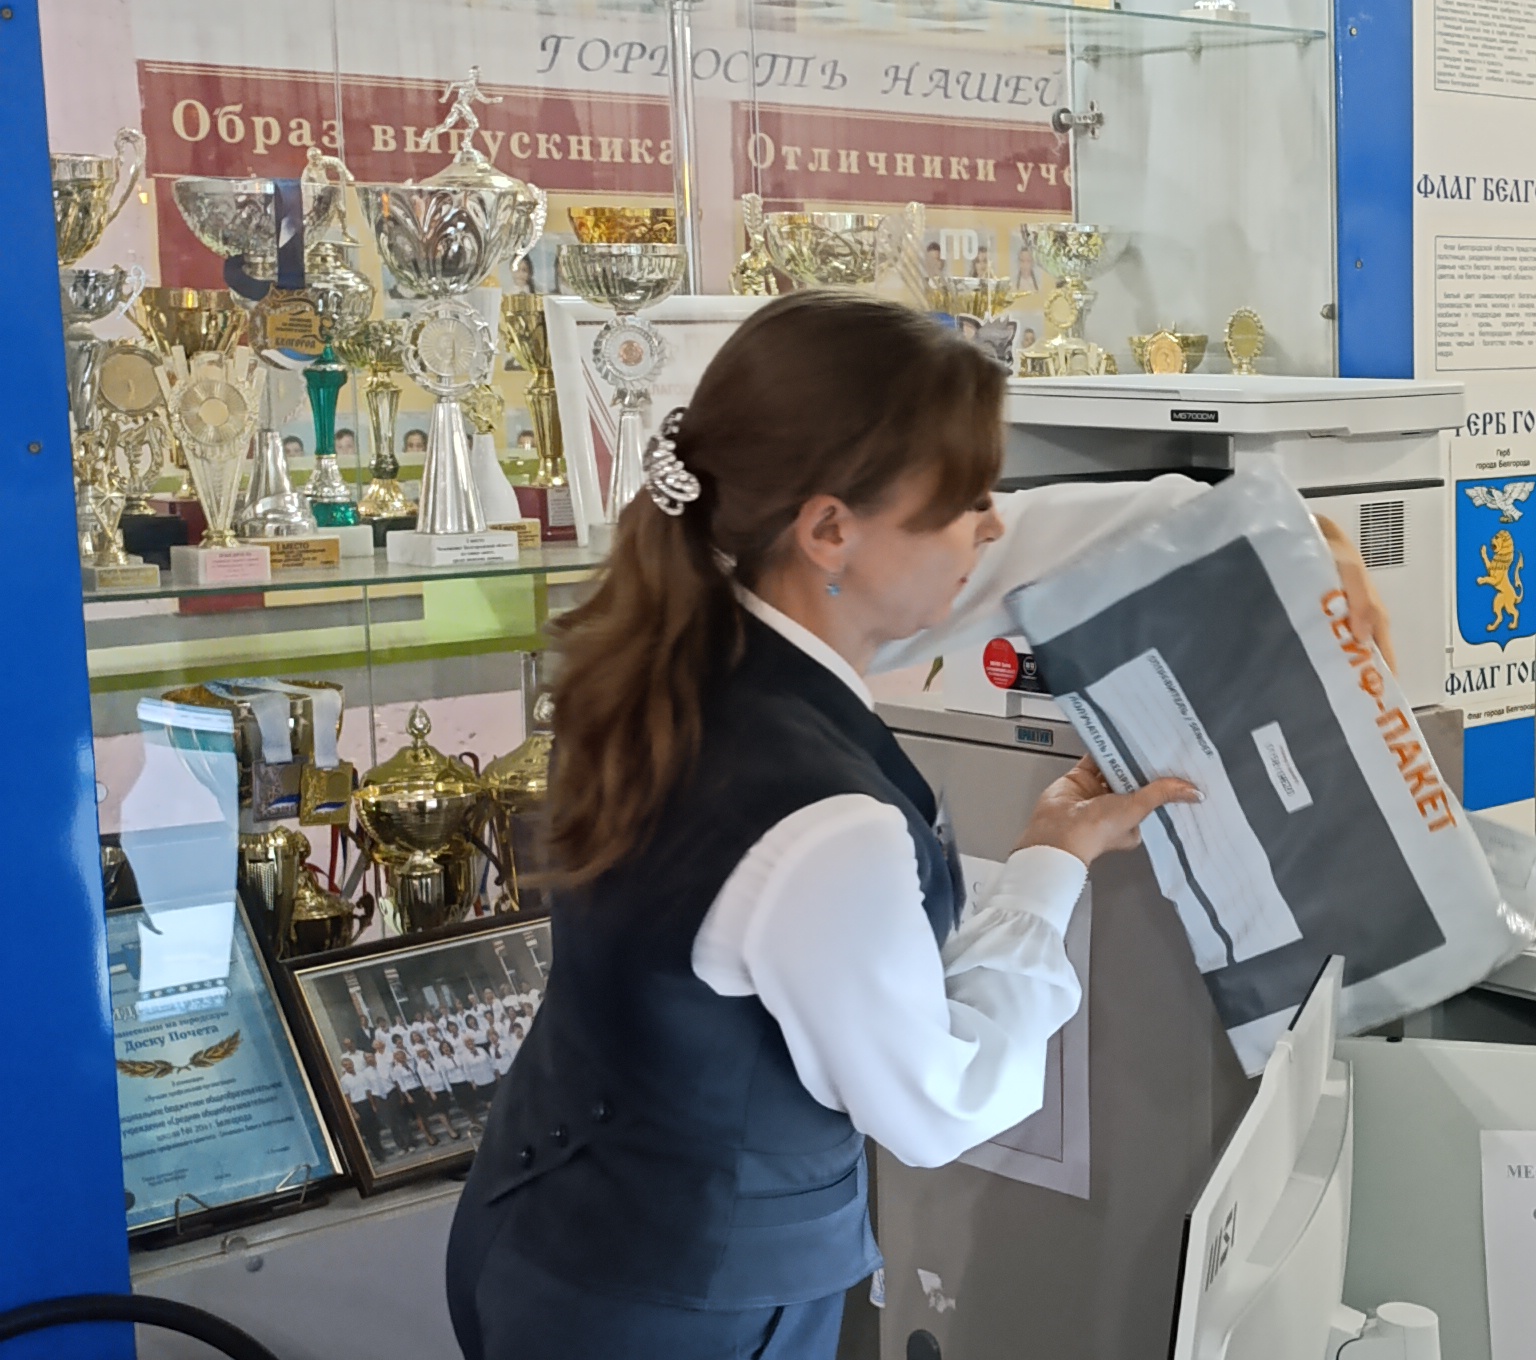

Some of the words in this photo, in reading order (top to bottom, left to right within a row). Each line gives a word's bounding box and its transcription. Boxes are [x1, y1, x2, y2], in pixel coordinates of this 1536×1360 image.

[881, 61, 1063, 107] НАШЕЙ
[172, 99, 347, 156] Образ
[372, 120, 675, 167] выпускника
[747, 132, 997, 183] Отличники
[1416, 173, 1477, 201] ФЛАГ
[1476, 460, 1497, 470] города
[1499, 458, 1530, 469] Белгорода
[1496, 448, 1511, 457] Герб
[1445, 665, 1500, 695] ФЛАГ
[1069, 695, 1107, 754] ПОЛУЧАТЕЛЬ
[1484, 708, 1504, 718] города
[124, 1035, 165, 1053] Доску
[168, 1024, 219, 1042] Почета
